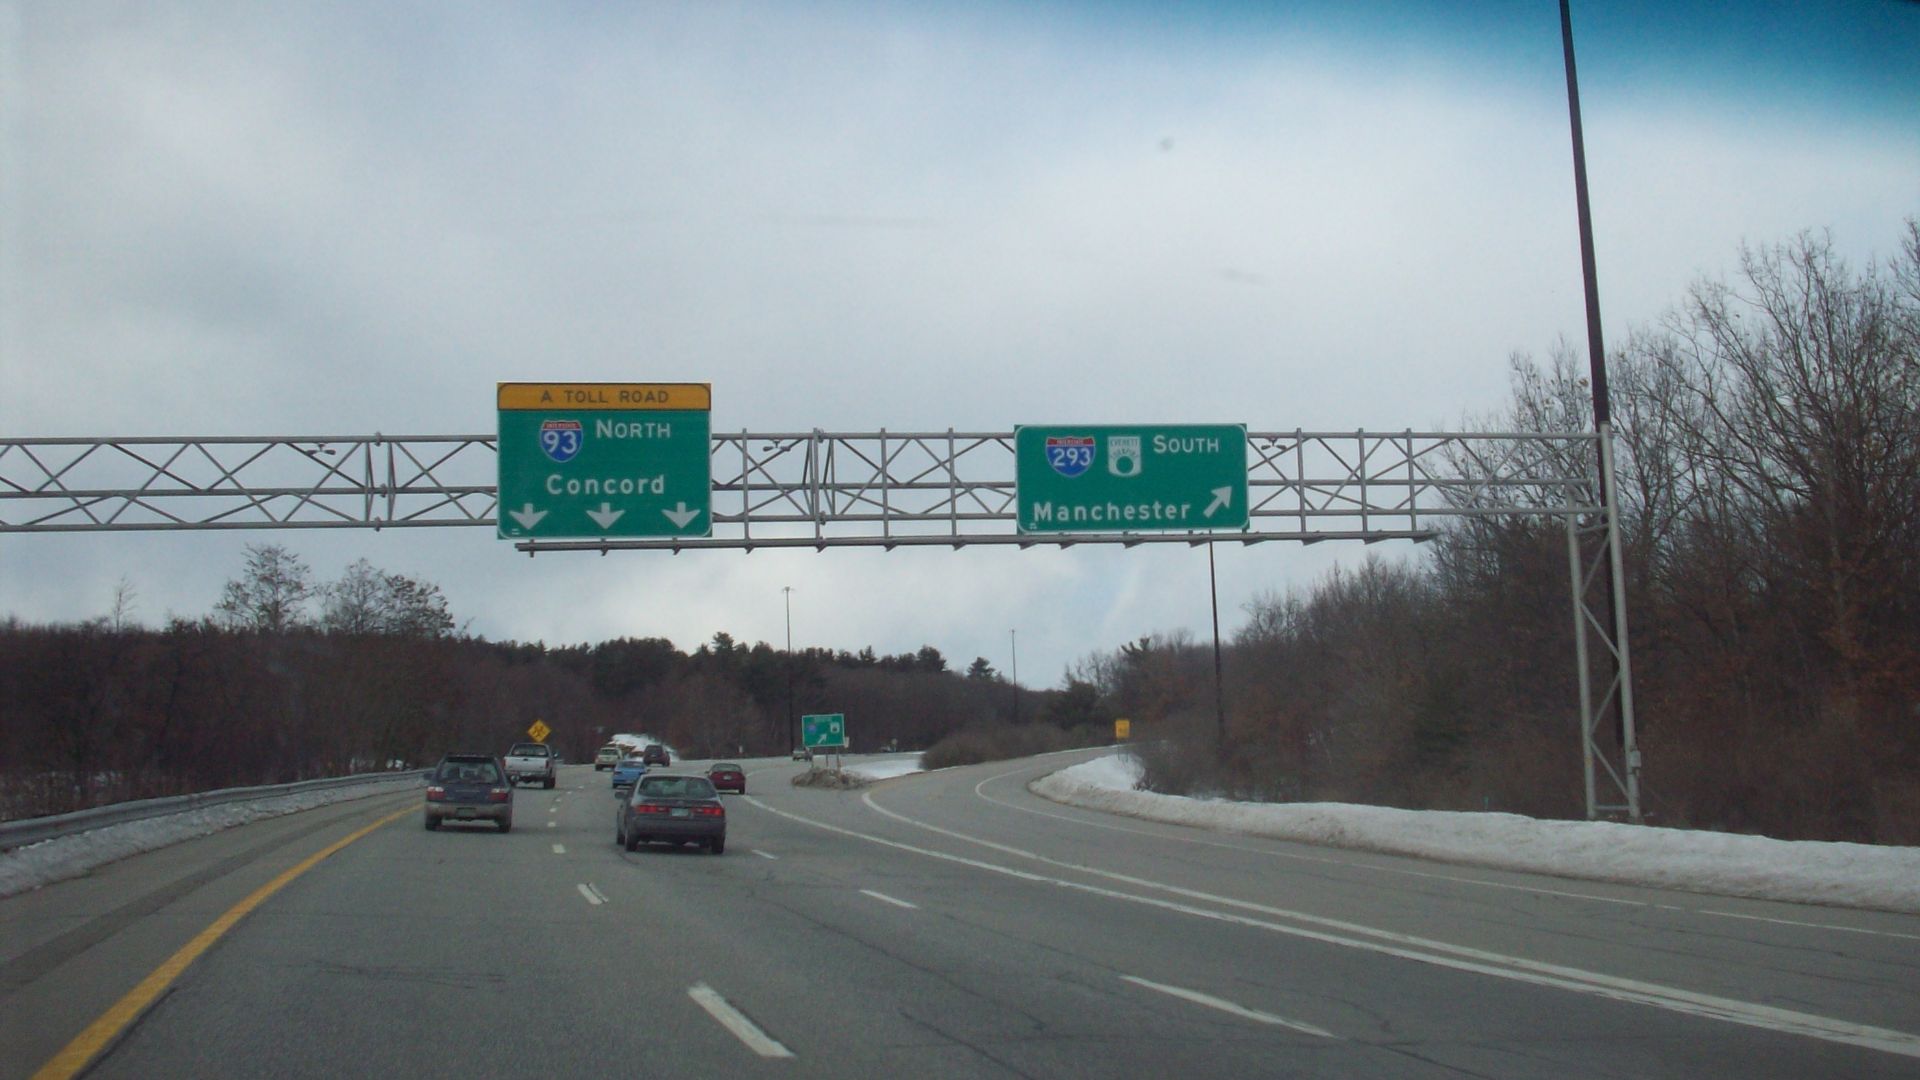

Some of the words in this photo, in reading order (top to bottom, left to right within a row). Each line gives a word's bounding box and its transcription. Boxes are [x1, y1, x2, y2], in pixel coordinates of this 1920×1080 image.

[541, 390, 553, 403] A
[564, 390, 609, 403] TOLL
[619, 390, 670, 403] ROAD
[596, 419, 671, 438] NORTH
[543, 431, 578, 454] 93
[1153, 434, 1220, 454] SOUTH
[1053, 448, 1091, 467] 293
[546, 474, 665, 495] Concord
[1033, 500, 1191, 522] Manchester
